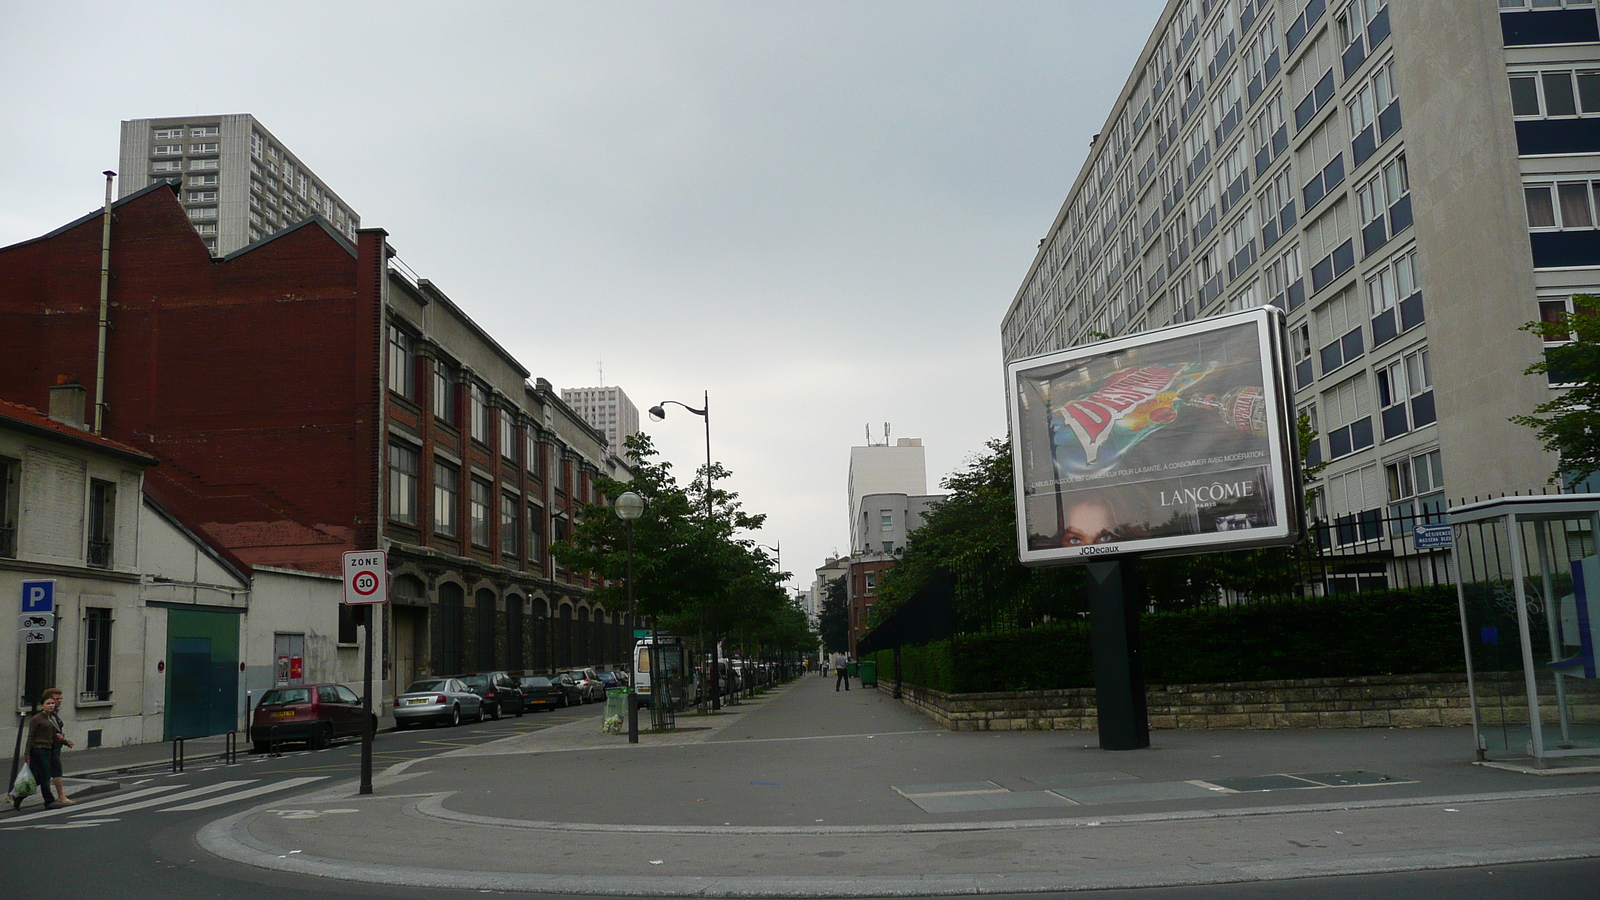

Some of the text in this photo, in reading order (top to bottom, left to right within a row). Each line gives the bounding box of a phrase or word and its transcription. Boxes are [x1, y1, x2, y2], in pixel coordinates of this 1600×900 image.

[1060, 363, 1186, 463] DESPER
[1118, 468, 1134, 477] POUR
[1169, 459, 1207, 469] CONSOMMER
[1207, 456, 1223, 464] AVEC
[1160, 480, 1254, 507] LANCÔME
[1079, 545, 1119, 556] JCDecaux
[351, 557, 379, 567] ZONE
[358, 578, 373, 588] 30
[30, 586, 45, 608] P
